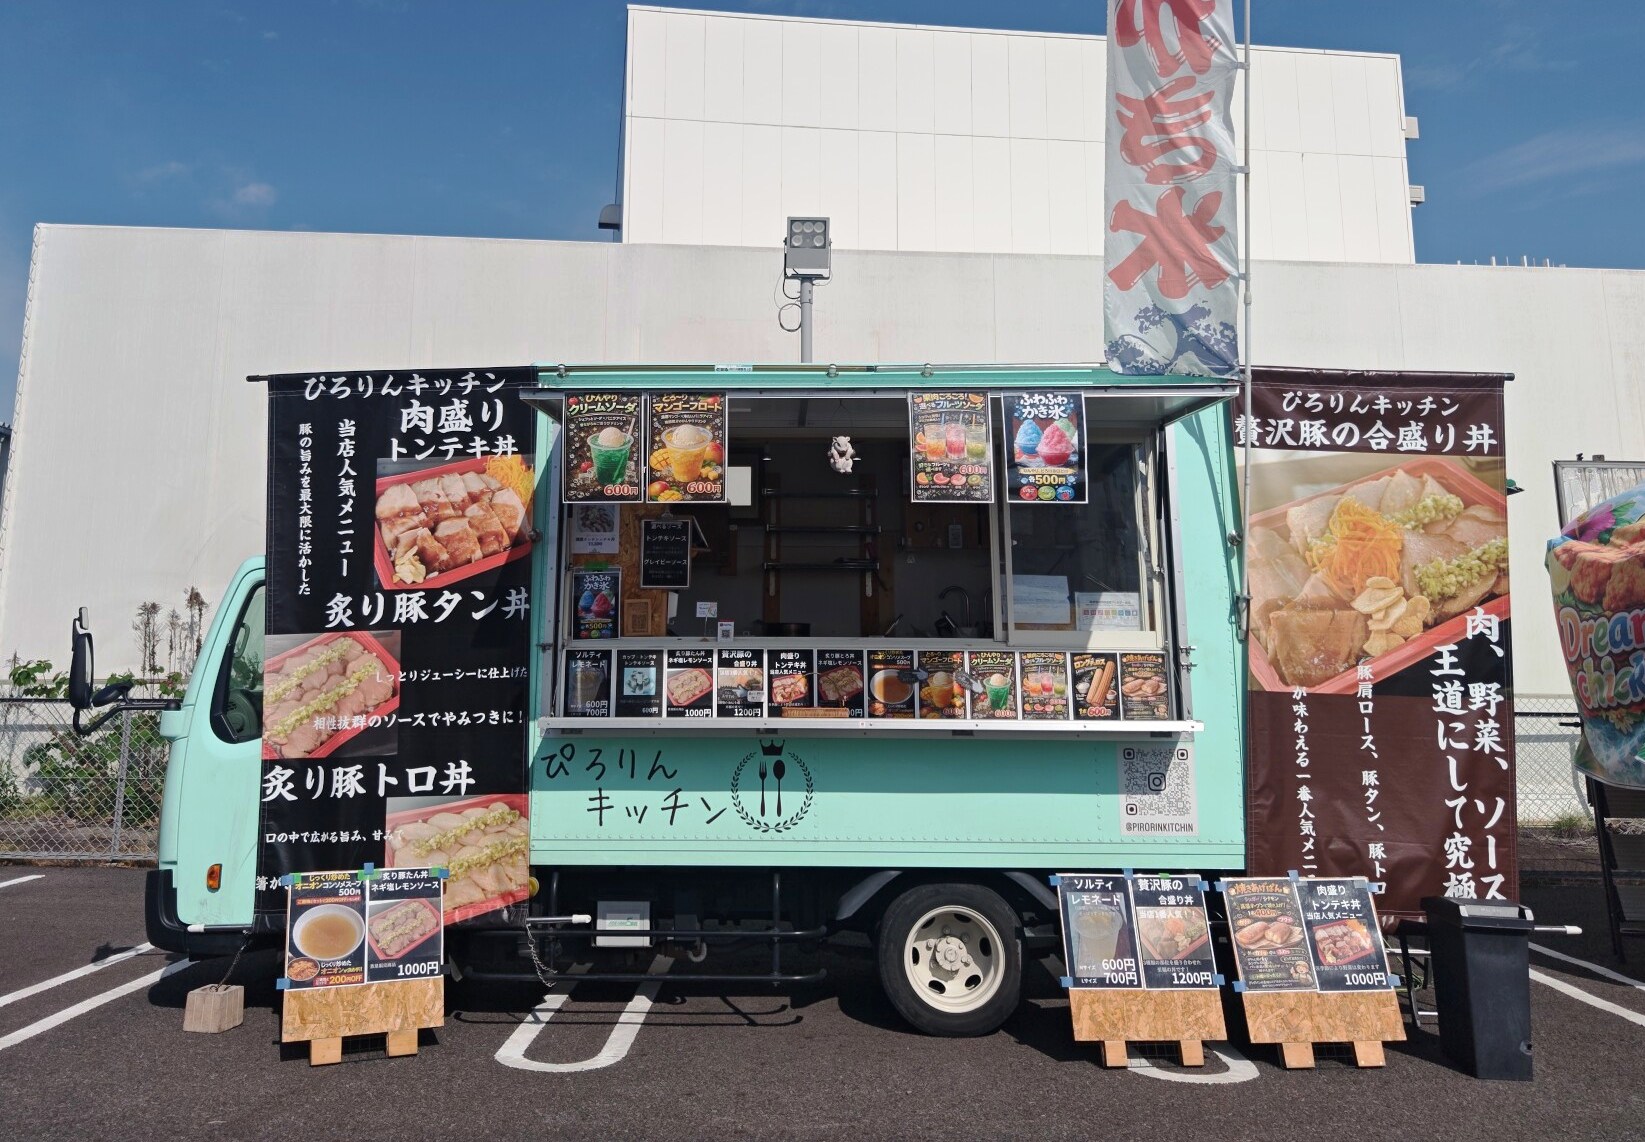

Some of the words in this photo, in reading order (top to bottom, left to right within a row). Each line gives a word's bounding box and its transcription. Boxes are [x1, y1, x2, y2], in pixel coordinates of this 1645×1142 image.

[304, 371, 506, 401] ぴろりんキッチン
[1020, 393, 1067, 405] ふわふわ
[1282, 391, 1460, 417] ぴろりんキッチン
[568, 402, 637, 415] クリームソーダ
[652, 402, 722, 412] マンゴーフロート
[1022, 405, 1068, 419] かき氷
[400, 398, 504, 434] 肉盛り
[1235, 414, 1498, 455] 贅沢豚の合盛り丼
[390, 434, 519, 462] トンテキ丼
[604, 485, 639, 496] 600円
[687, 482, 721, 493] 600円
[336, 418, 358, 577] 当店人気メニュー
[298, 422, 313, 596] 豚の旨みを最大限に活かした
[583, 581, 611, 590] かき氷
[325, 587, 530, 628] 炙り豚タン丼
[376, 666, 528, 683] しっとりジューシーに仕上げた
[585, 700, 608, 708] 600円
[585, 708, 608, 716] 700円
[684, 709, 712, 717] 1000円
[733, 708, 761, 717] 1200円
[313, 710, 524, 730] 相性抜群のソースでやみつきに!
[1465, 606, 1508, 901] 肉、野菜、ソース
[541, 743, 678, 781] ぴろりん
[1430, 644, 1478, 900] 王道にして究極
[261, 760, 476, 801] 炙り豚トロ丼
[1292, 685, 1318, 878] が味わえる一番人気メニ
[587, 788, 727, 826] キッチン
[1126, 822, 1194, 832] @PIRORINKITCHIN
[382, 871, 428, 880] 炙り豚たん丼
[295, 880, 361, 890] オニオンコンソメスープ
[371, 881, 440, 892] ネギ塩レモンソース
[1074, 879, 1113, 890] ソルティ
[1138, 879, 1183, 891] 贅沢豚の
[1317, 885, 1346, 896] 肉盛り
[338, 888, 361, 896] 500円
[1071, 894, 1121, 906] レモネード
[1158, 894, 1194, 906] 合盛り丼
[1312, 899, 1362, 910] トンテキ丼
[397, 961, 439, 976] 1000円
[1101, 959, 1136, 972] 600円
[1103, 972, 1138, 985] 700円
[1172, 972, 1213, 985] 1200円
[1344, 972, 1387, 986] 1000円
